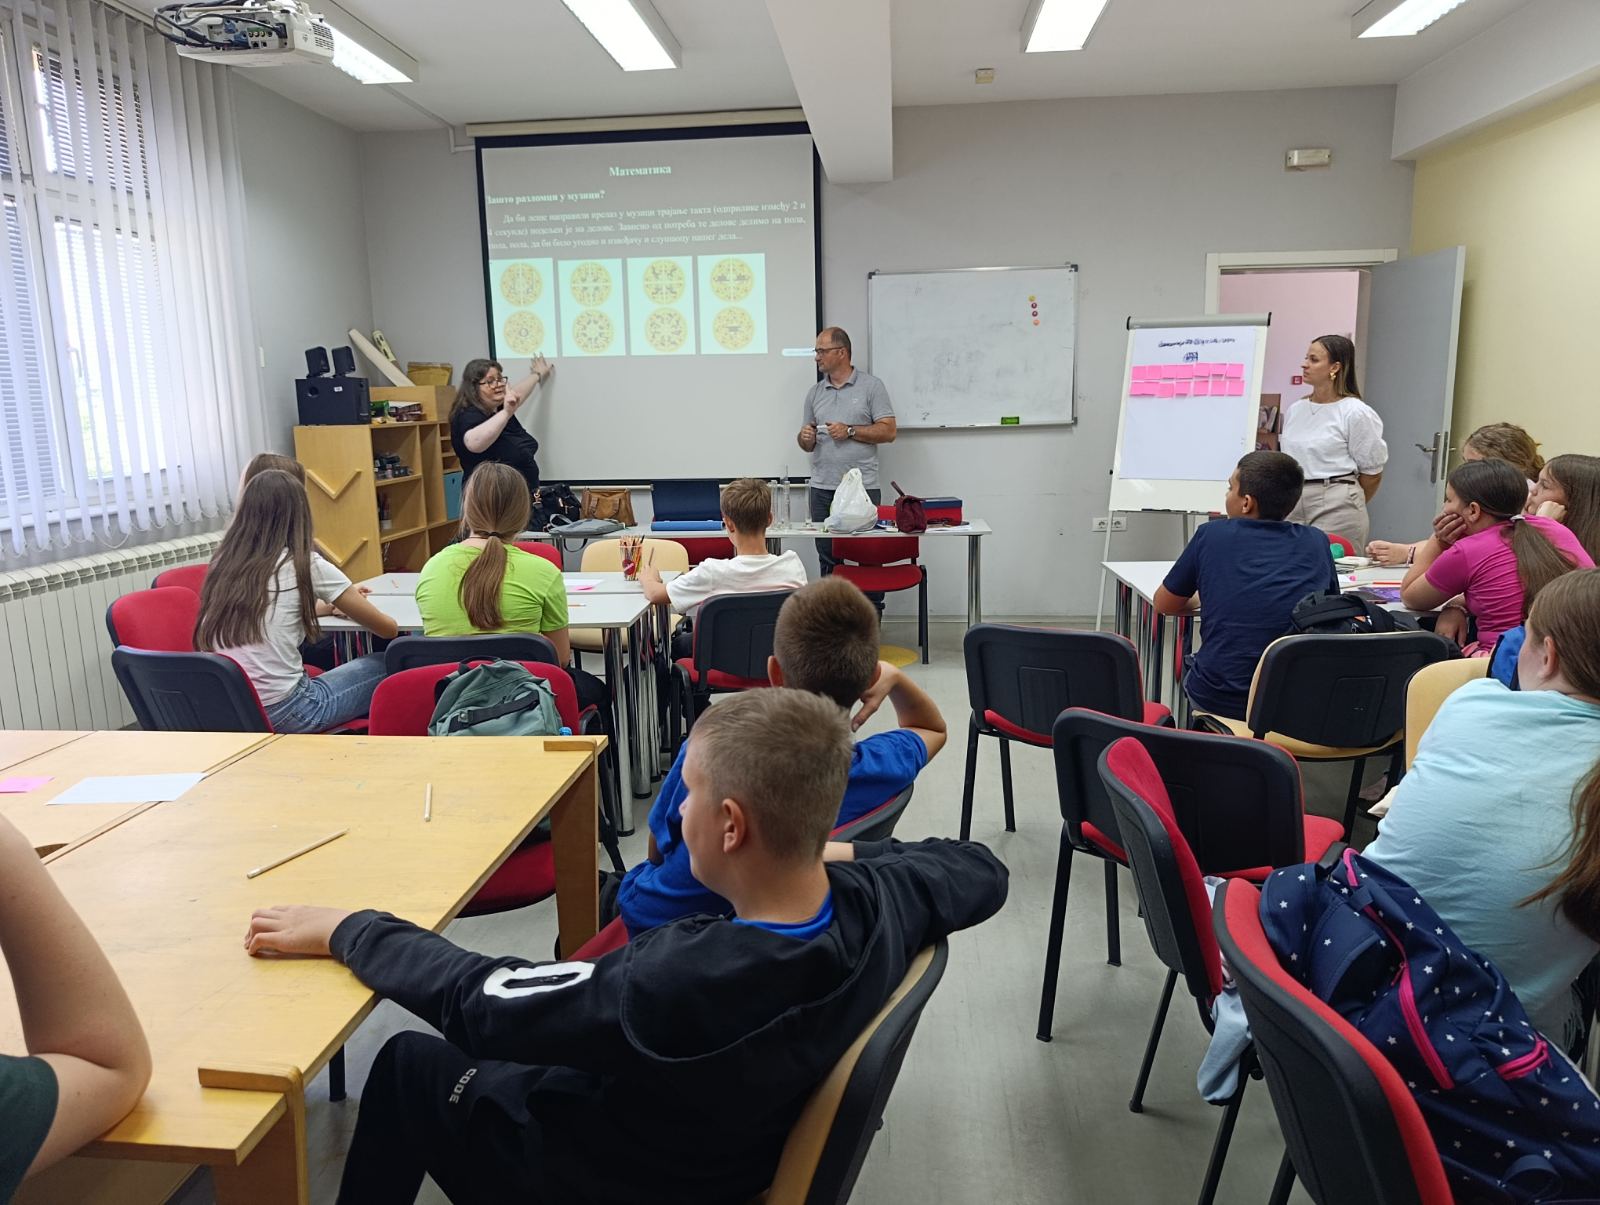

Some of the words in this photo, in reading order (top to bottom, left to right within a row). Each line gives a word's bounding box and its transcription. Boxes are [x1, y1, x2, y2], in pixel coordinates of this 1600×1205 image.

[609, 166, 671, 177] Математика
[515, 194, 558, 205] разломци
[560, 193, 566, 203] у
[567, 190, 606, 202] музици?
[503, 214, 514, 223] Да
[515, 213, 526, 222] би
[618, 210, 625, 220] у
[626, 209, 655, 219] музици
[792, 201, 798, 210] 2
[564, 224, 573, 236] је
[449, 1068, 478, 1104] CODE
